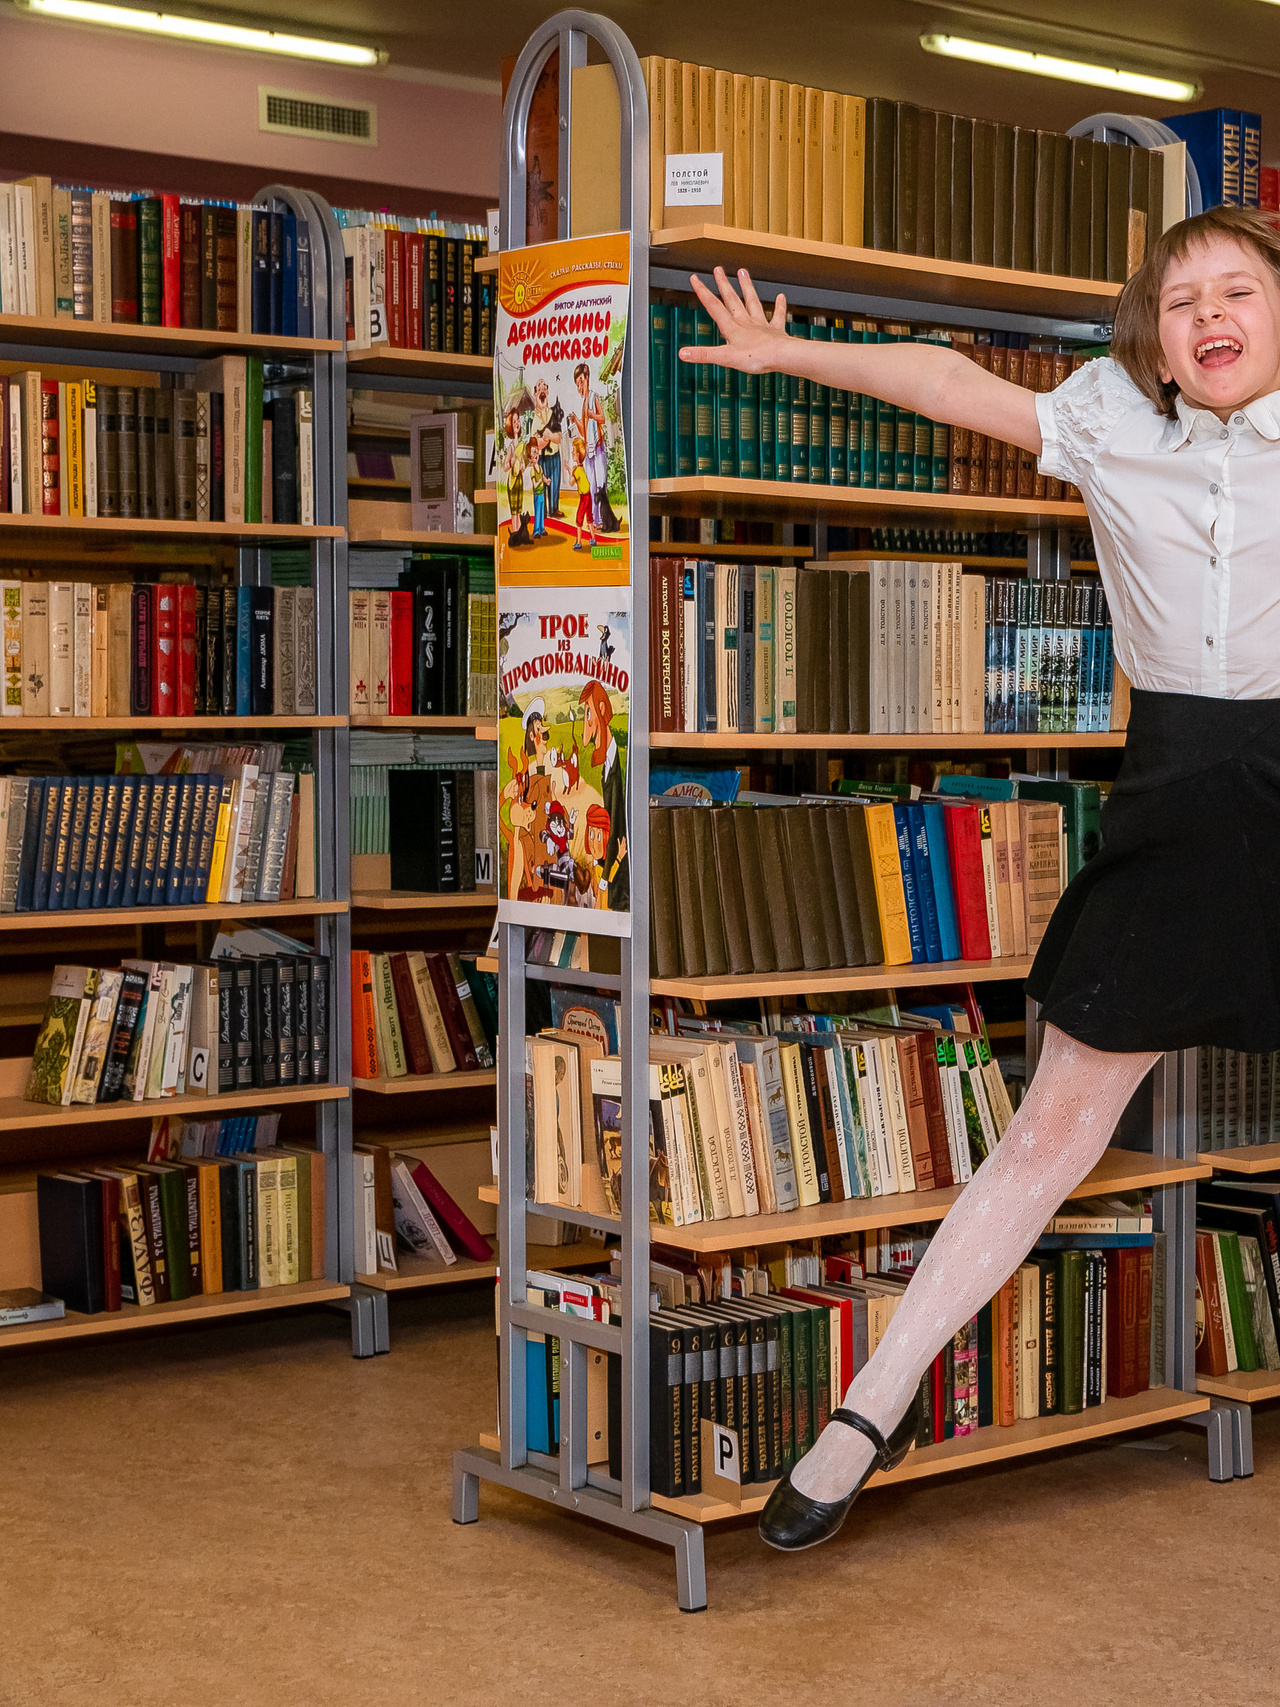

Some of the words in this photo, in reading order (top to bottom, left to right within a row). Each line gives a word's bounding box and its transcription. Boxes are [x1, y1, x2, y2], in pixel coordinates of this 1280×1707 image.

[671, 169, 708, 178] ТОЛСТОЙ
[447, 285, 454, 303] 2
[463, 285, 472, 305] 3
[554, 300, 575, 311] ВИКТОР
[575, 295, 612, 310] ДРАГУНСКИЙ
[507, 311, 611, 347] ДЕНИСКИНЫ
[523, 335, 609, 366] РАССКАЗЫ
[594, 546, 620, 557] ОНИКС
[538, 613, 589, 640] ТРОЕ
[784, 590, 793, 662] ТОЛСТОЙ
[557, 639, 571, 652] ИЗ
[502, 651, 630, 695] ПРОСТОКВАШИНО
[661, 630, 672, 717] ВОСКРЕСЕНИЕ
[426, 701, 432, 710] 8
[60, 786, 74, 836] ЛОНДОН
[89, 785, 105, 835] ЛОНДОН
[118, 786, 134, 835] ЛОНДОН
[164, 784, 179, 833] ЛОНДОН
[476, 853, 490, 880] М
[381, 961, 394, 1011] АЙВЕНГО
[389, 1016, 397, 1037] СКОТТ
[193, 1053, 205, 1083] С
[284, 1053, 291, 1062] 6
[131, 1214, 154, 1296] ФАУЛЗ
[192, 1266, 198, 1277] 2
[672, 1338, 681, 1354] 9
[692, 1334, 700, 1350] 8
[725, 1331, 733, 1346] 6
[739, 1329, 748, 1344] 4
[755, 1327, 764, 1342] 3
[673, 1385, 681, 1434] РОЛЛАН
[726, 1377, 734, 1426] РОЛЛАН
[691, 1433, 699, 1482] РОМЕН
[719, 1433, 734, 1471] Р
